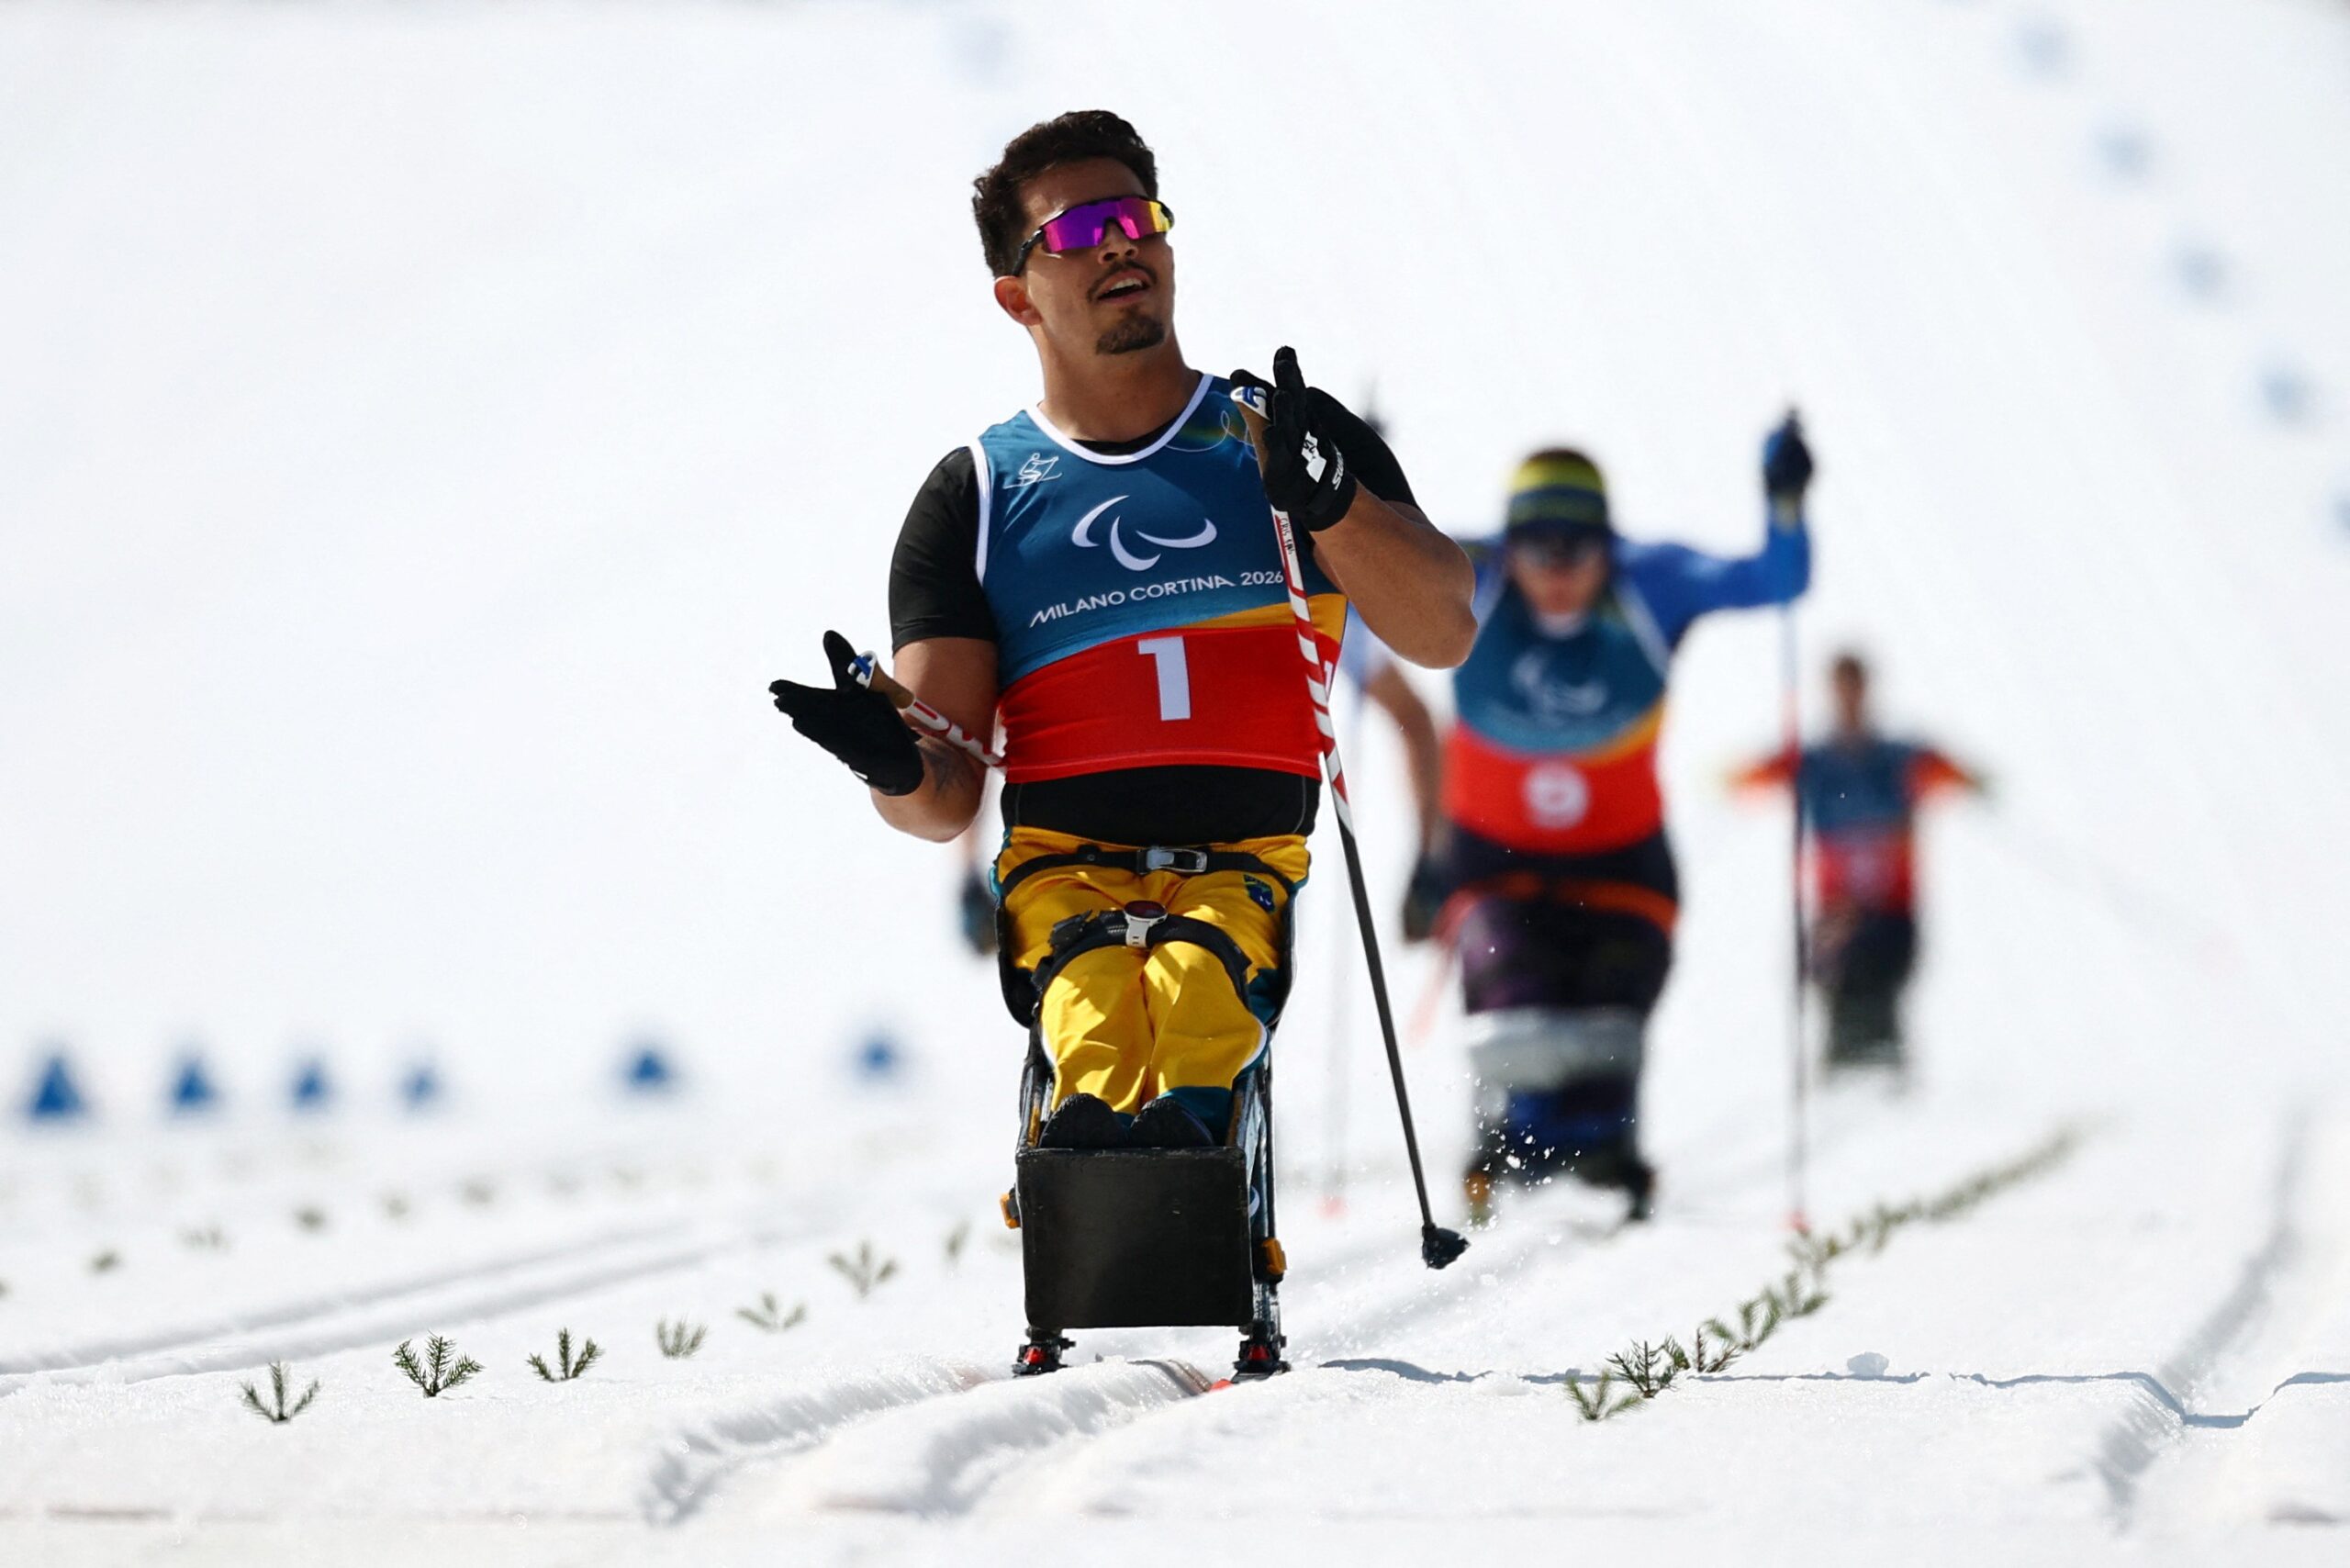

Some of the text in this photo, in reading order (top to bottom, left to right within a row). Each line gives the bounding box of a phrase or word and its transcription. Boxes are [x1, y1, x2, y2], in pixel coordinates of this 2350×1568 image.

[1029, 570, 1285, 628] MILANO CORTINA 2026
[1137, 635, 1192, 722] 1
